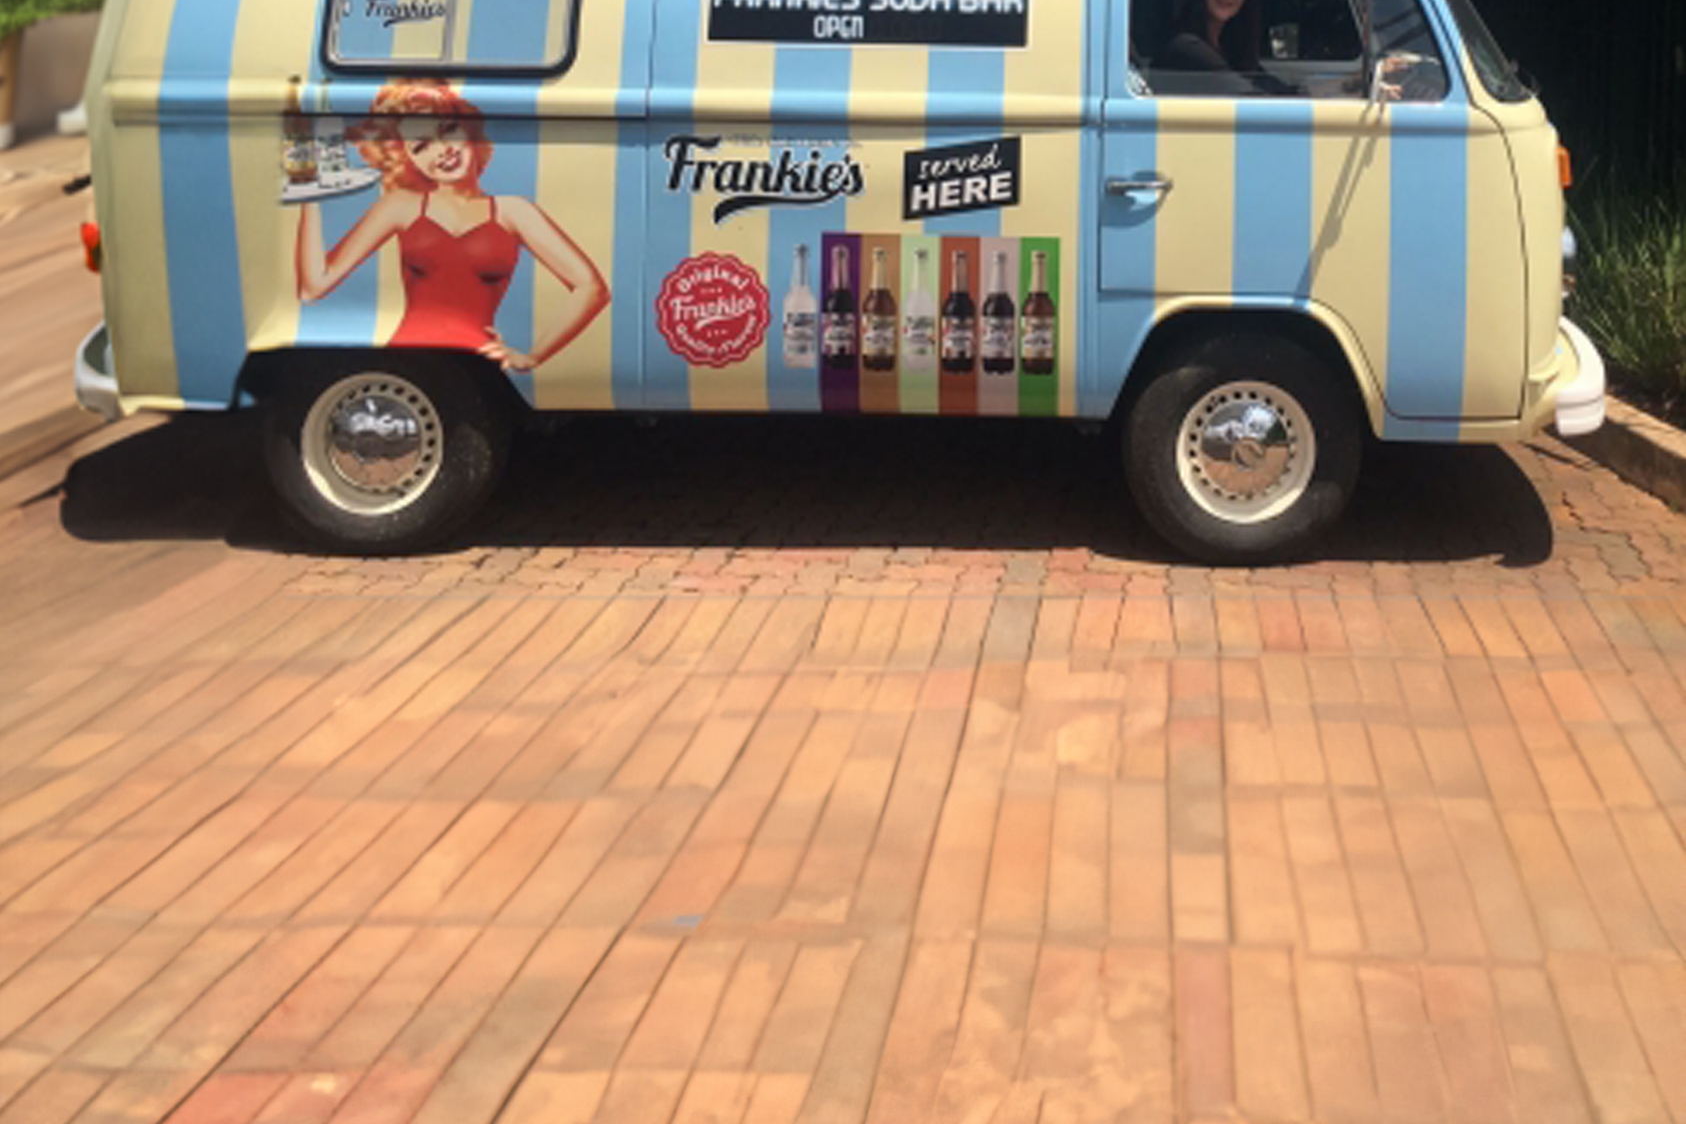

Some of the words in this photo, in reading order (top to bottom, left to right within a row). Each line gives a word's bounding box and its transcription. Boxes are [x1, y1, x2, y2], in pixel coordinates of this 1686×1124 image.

[813, 14, 864, 38] OPEN
[664, 135, 864, 224] Frankie's
[919, 143, 1002, 180] served
[910, 172, 1012, 212] HERE
